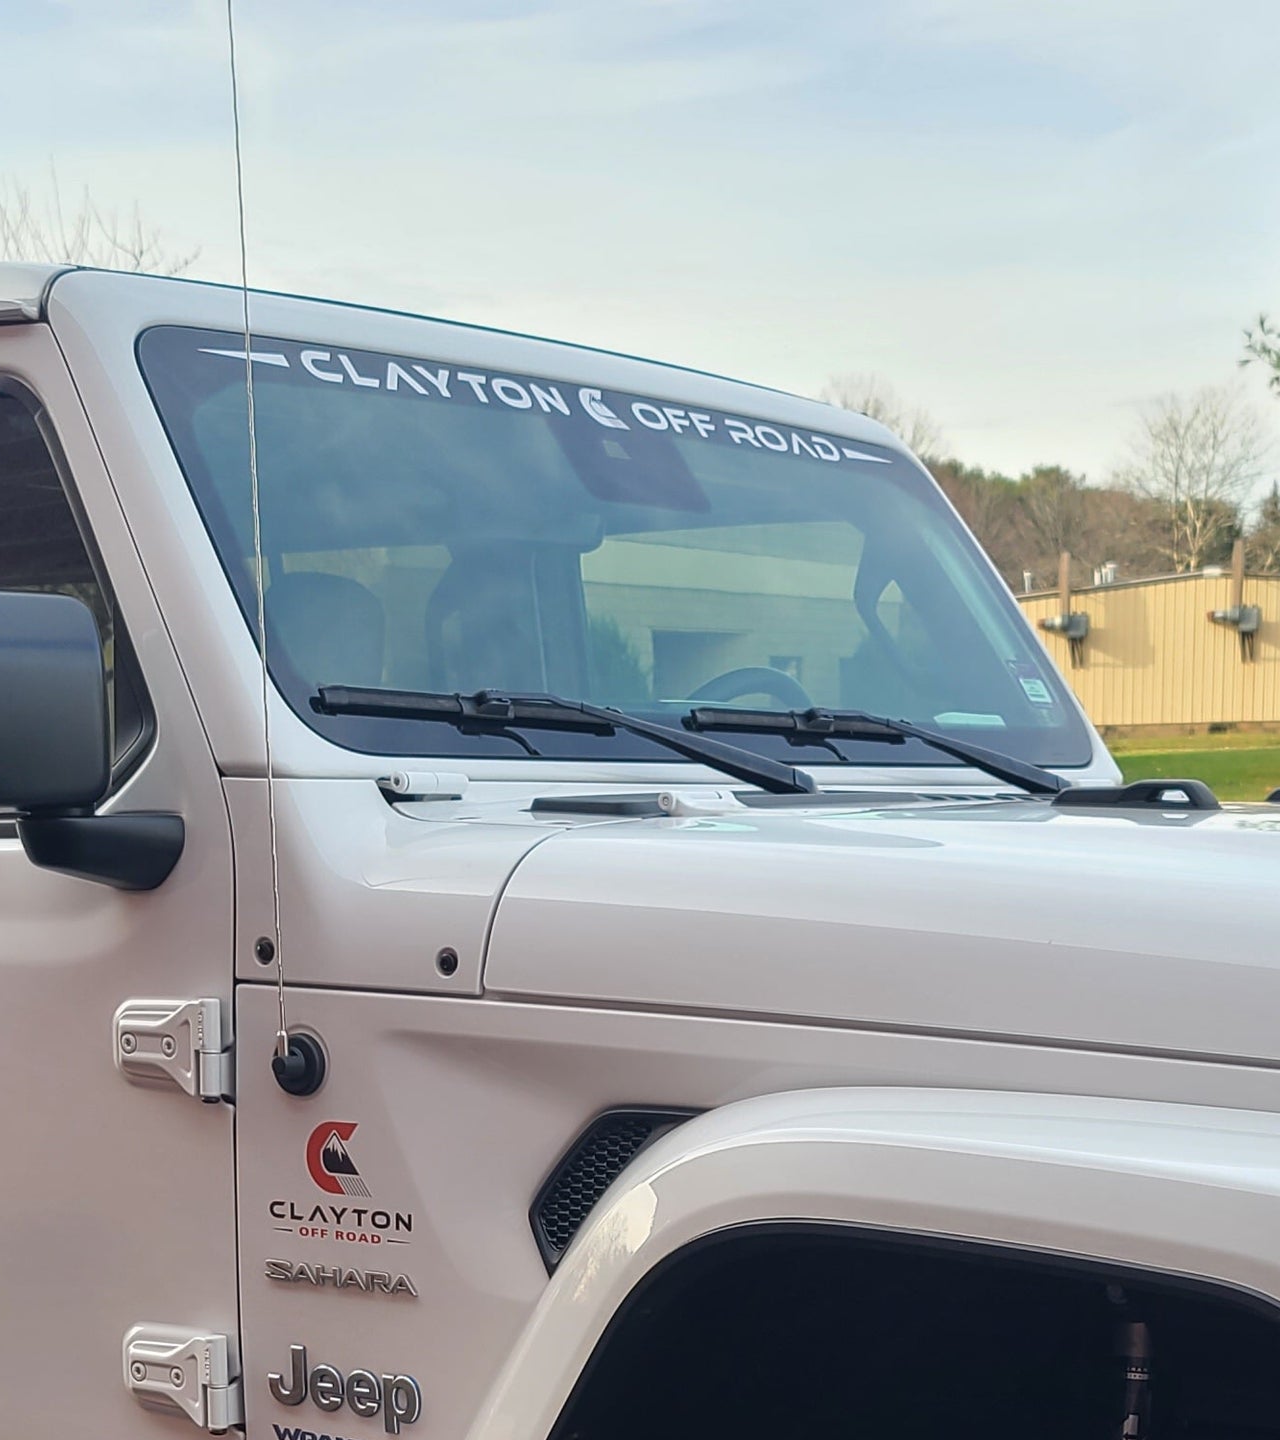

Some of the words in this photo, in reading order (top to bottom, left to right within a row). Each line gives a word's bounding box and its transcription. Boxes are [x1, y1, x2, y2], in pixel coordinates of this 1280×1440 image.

[299, 349, 571, 418] CLAYTON
[632, 403, 717, 439] OFF
[724, 417, 843, 463] ROAD
[269, 1200, 414, 1233] CLAYTON
[298, 1226, 329, 1240] OFF
[335, 1229, 383, 1245] ROAD
[264, 1257, 419, 1299] SAHARA
[267, 1343, 422, 1435] Jeep
